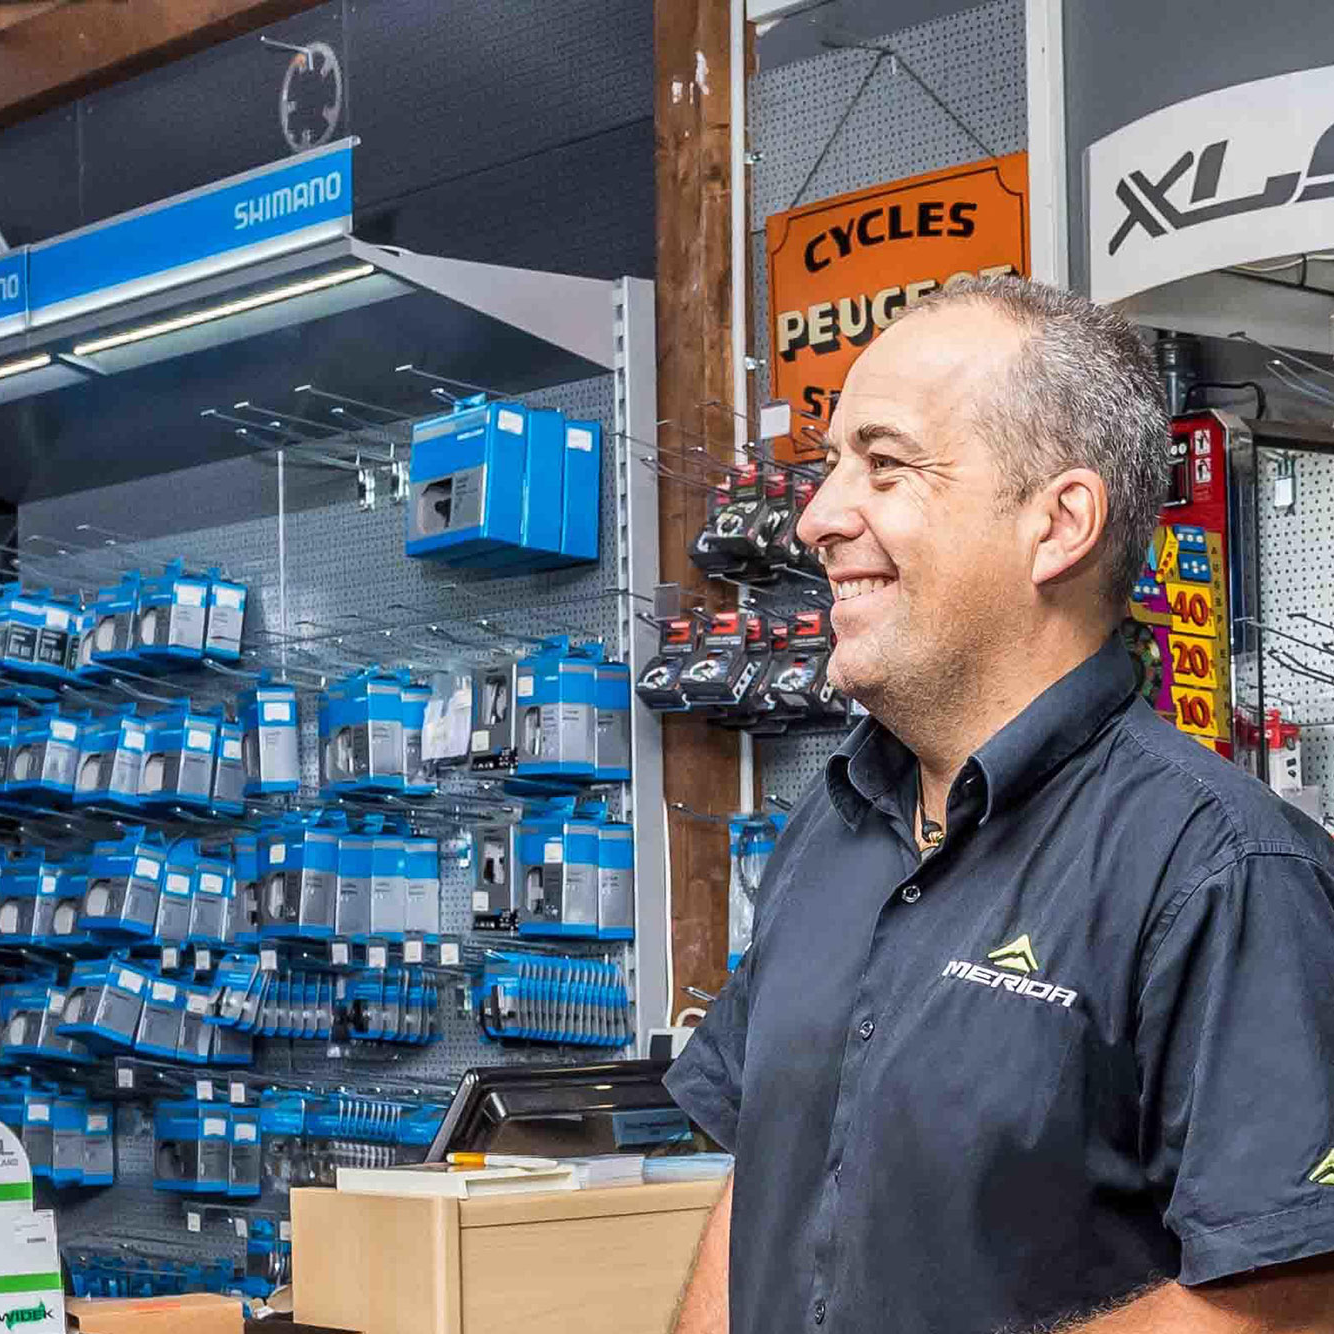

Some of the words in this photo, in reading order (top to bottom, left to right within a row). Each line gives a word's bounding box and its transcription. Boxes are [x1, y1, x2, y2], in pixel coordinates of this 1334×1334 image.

[234, 171, 342, 230] SHIMANO
[803, 202, 977, 272] CYCLES
[1171, 591, 1208, 627] 40
[1172, 644, 1209, 678] 20
[1178, 696, 1210, 729] 10
[942, 961, 1078, 1007] MERIDA
